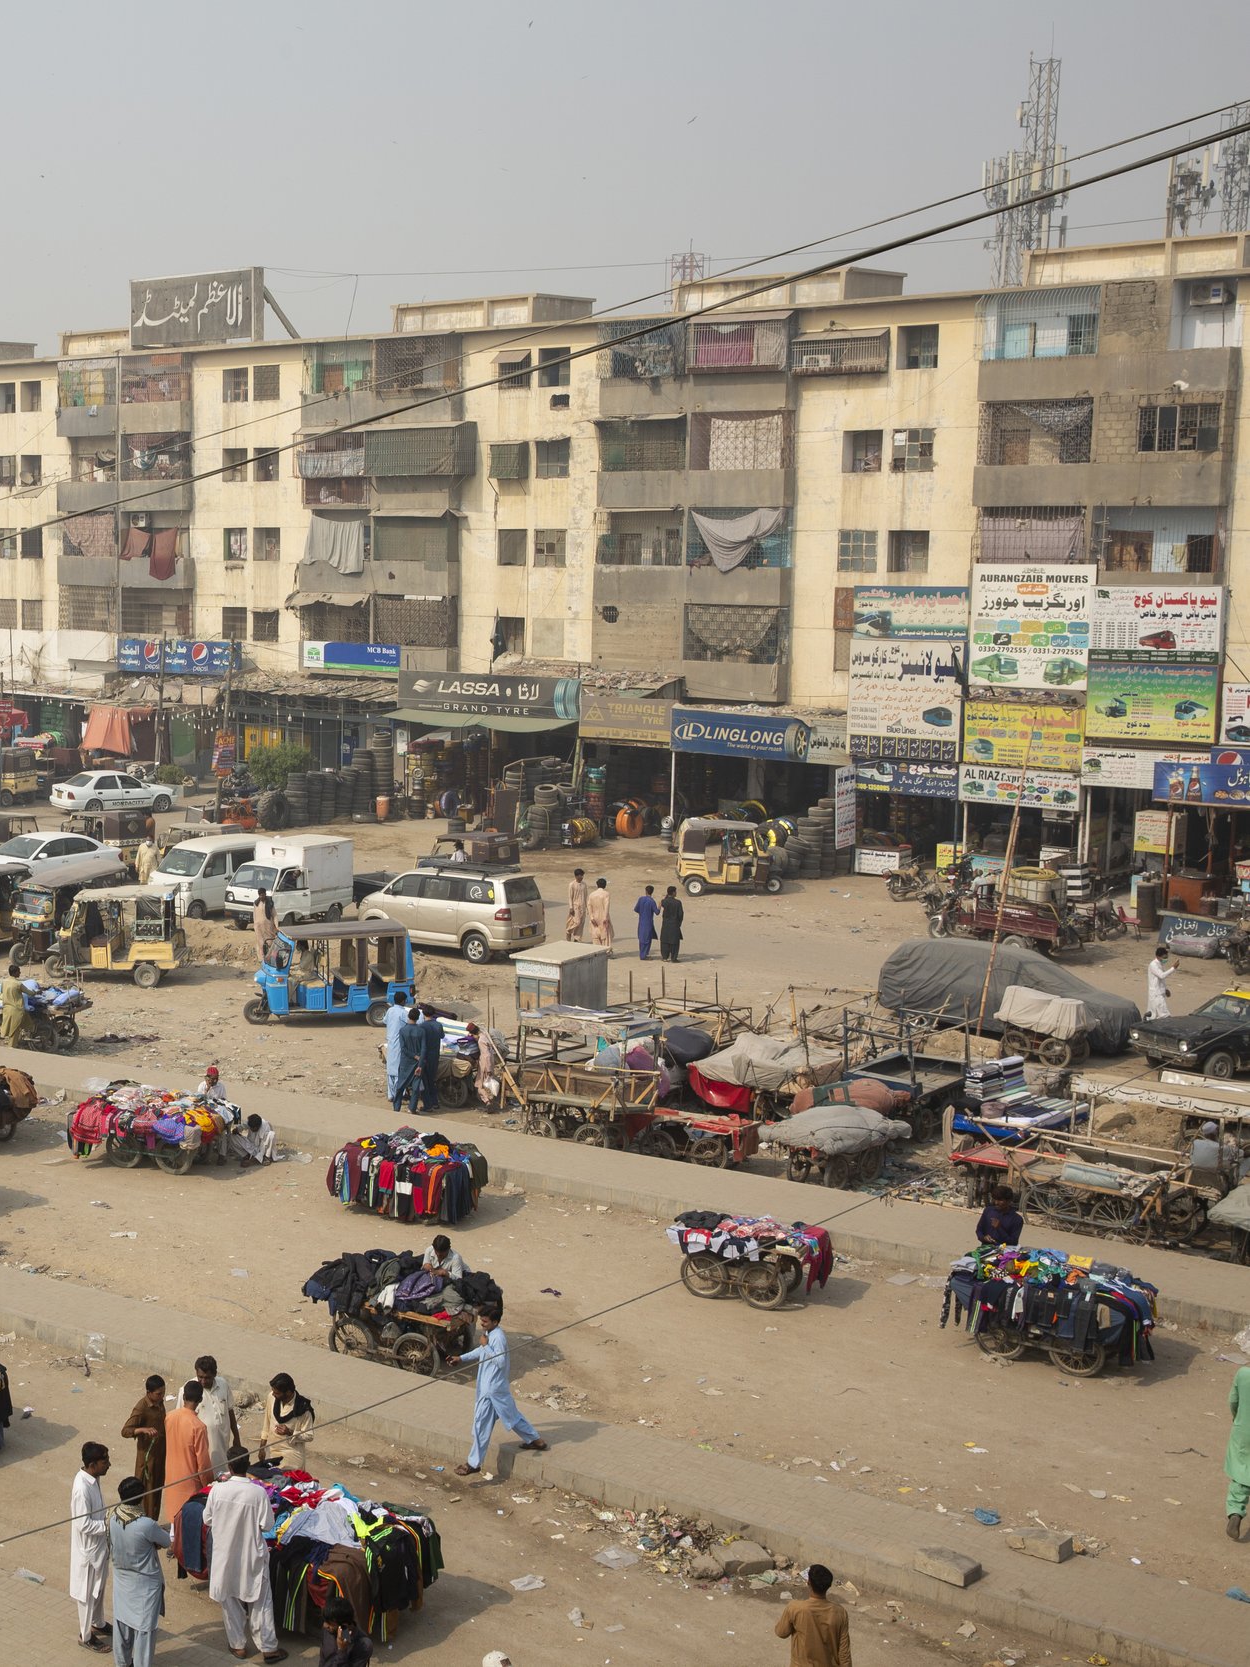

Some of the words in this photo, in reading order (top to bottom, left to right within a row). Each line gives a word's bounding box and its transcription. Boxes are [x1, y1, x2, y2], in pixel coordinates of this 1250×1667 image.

[980, 574, 1043, 583] AURANGZAIB
[1045, 575, 1089, 584] MOVERS
[1155, 591, 1198, 609] پاکستان
[367, 646, 382, 654] MCB
[382, 647, 397, 655] Bank
[1033, 648, 1084, 656] 0331-2792555
[145, 663, 160, 671] pepsi
[192, 665, 209, 673] pepsi
[437, 680, 500, 697] LASSA
[443, 703, 489, 713] GRAND
[496, 706, 530, 715] TYRE
[607, 703, 667, 716] TRIANGLE
[642, 715, 665, 725] TYRE
[703, 725, 785, 746] LINGLONG
[886, 725, 901, 734] Blue
[901, 726, 917, 735] Lines
[909, 762, 931, 775] کوچ
[964, 768, 976, 779] AL
[978, 769, 1000, 781] RIAZ
[1000, 771, 1035, 784] Exprss
